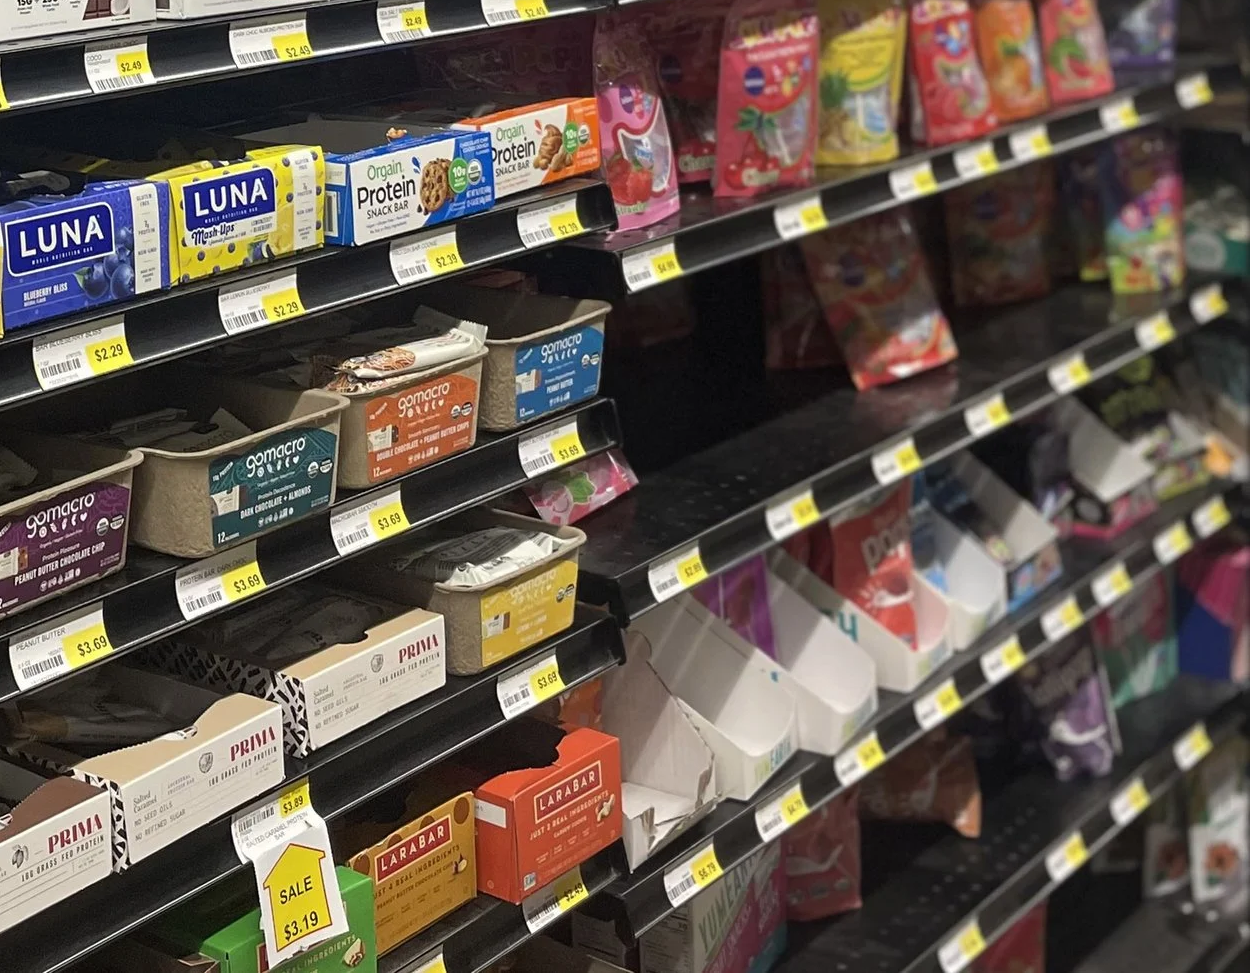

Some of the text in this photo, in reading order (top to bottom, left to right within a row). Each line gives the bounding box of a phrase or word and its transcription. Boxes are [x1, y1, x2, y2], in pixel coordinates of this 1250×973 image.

[120, 60, 142, 73] $2.49
[367, 161, 403, 182] Orgain
[194, 178, 268, 217] LUNA
[357, 177, 416, 209] Protein
[367, 201, 408, 219] SNACK BAR
[19, 218, 104, 257] LUNA
[435, 253, 458, 267] $2.39
[273, 302, 299, 317] $2.29
[94, 344, 123, 362] $2.29
[246, 436, 306, 478] gomacro
[378, 512, 402, 530] $3.69
[234, 573, 260, 593] $3.69
[230, 726, 276, 761] PRIMA
[283, 796, 304, 814] $3.89
[538, 770, 596, 811] LARABAR
[48, 814, 103, 854] PRIMA
[381, 825, 445, 872] LARABAR
[279, 876, 313, 905] SALE
[284, 911, 319, 942] $3.19
